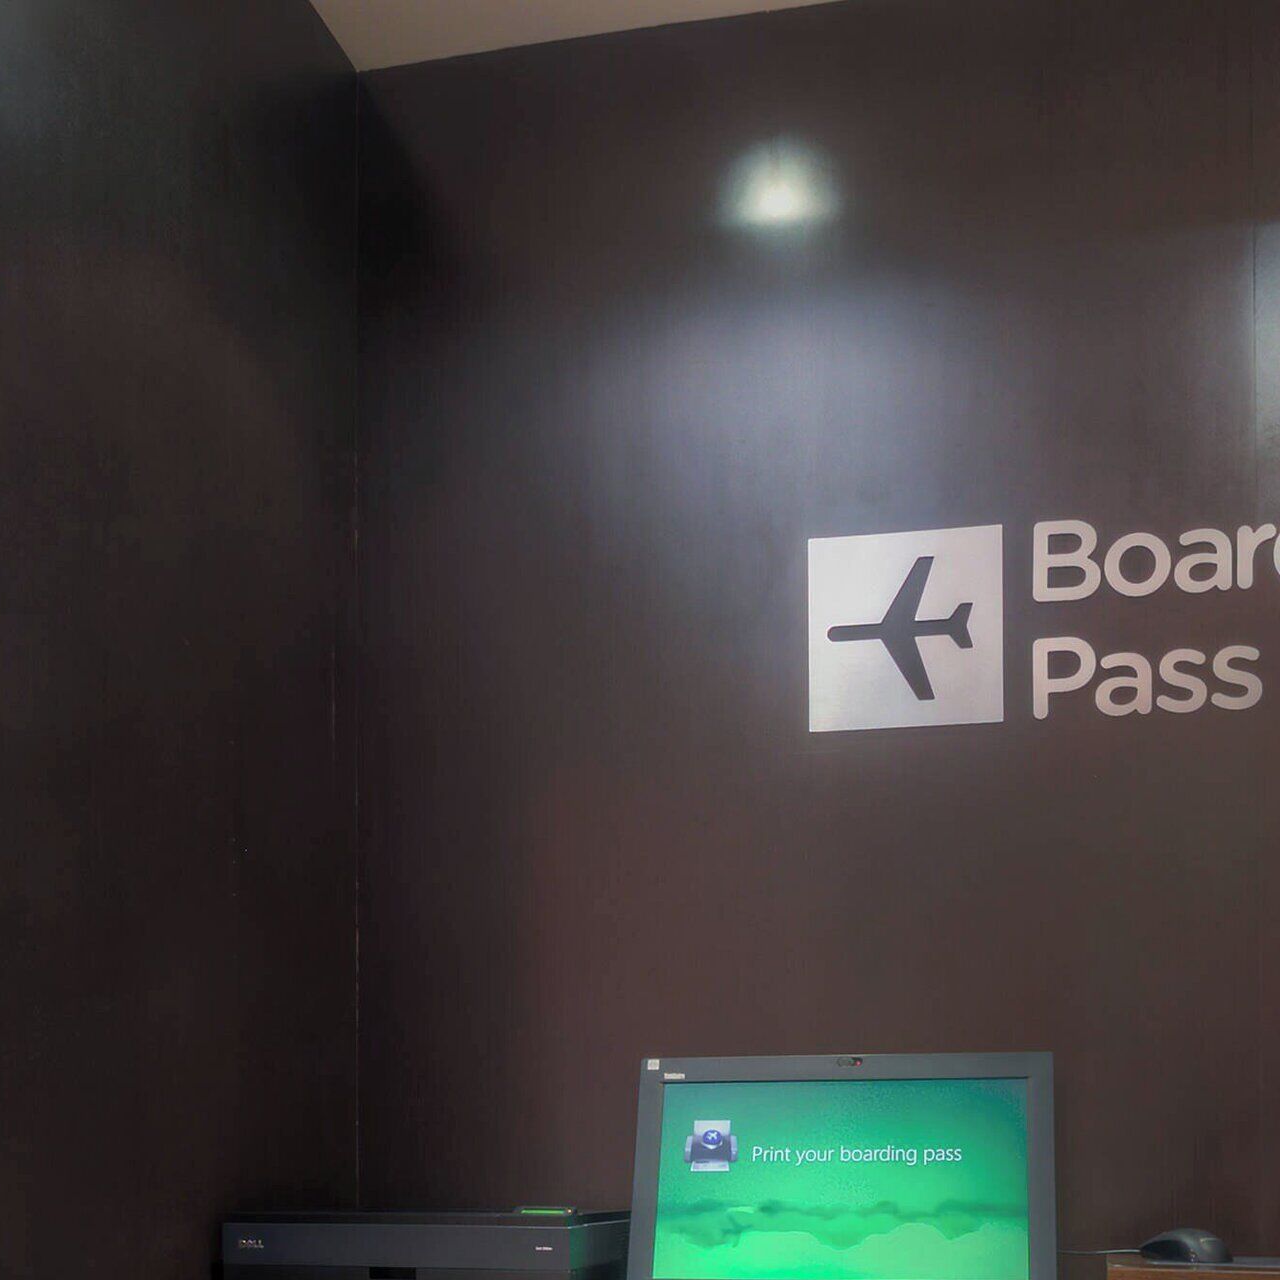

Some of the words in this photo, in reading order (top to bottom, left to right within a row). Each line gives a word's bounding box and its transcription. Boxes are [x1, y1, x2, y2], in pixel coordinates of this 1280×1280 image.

[1032, 636, 1264, 720] Pass
[751, 1146, 791, 1163] Print
[796, 1147, 835, 1167] your
[839, 1145, 918, 1166] boarding
[922, 1147, 963, 1166] pass
